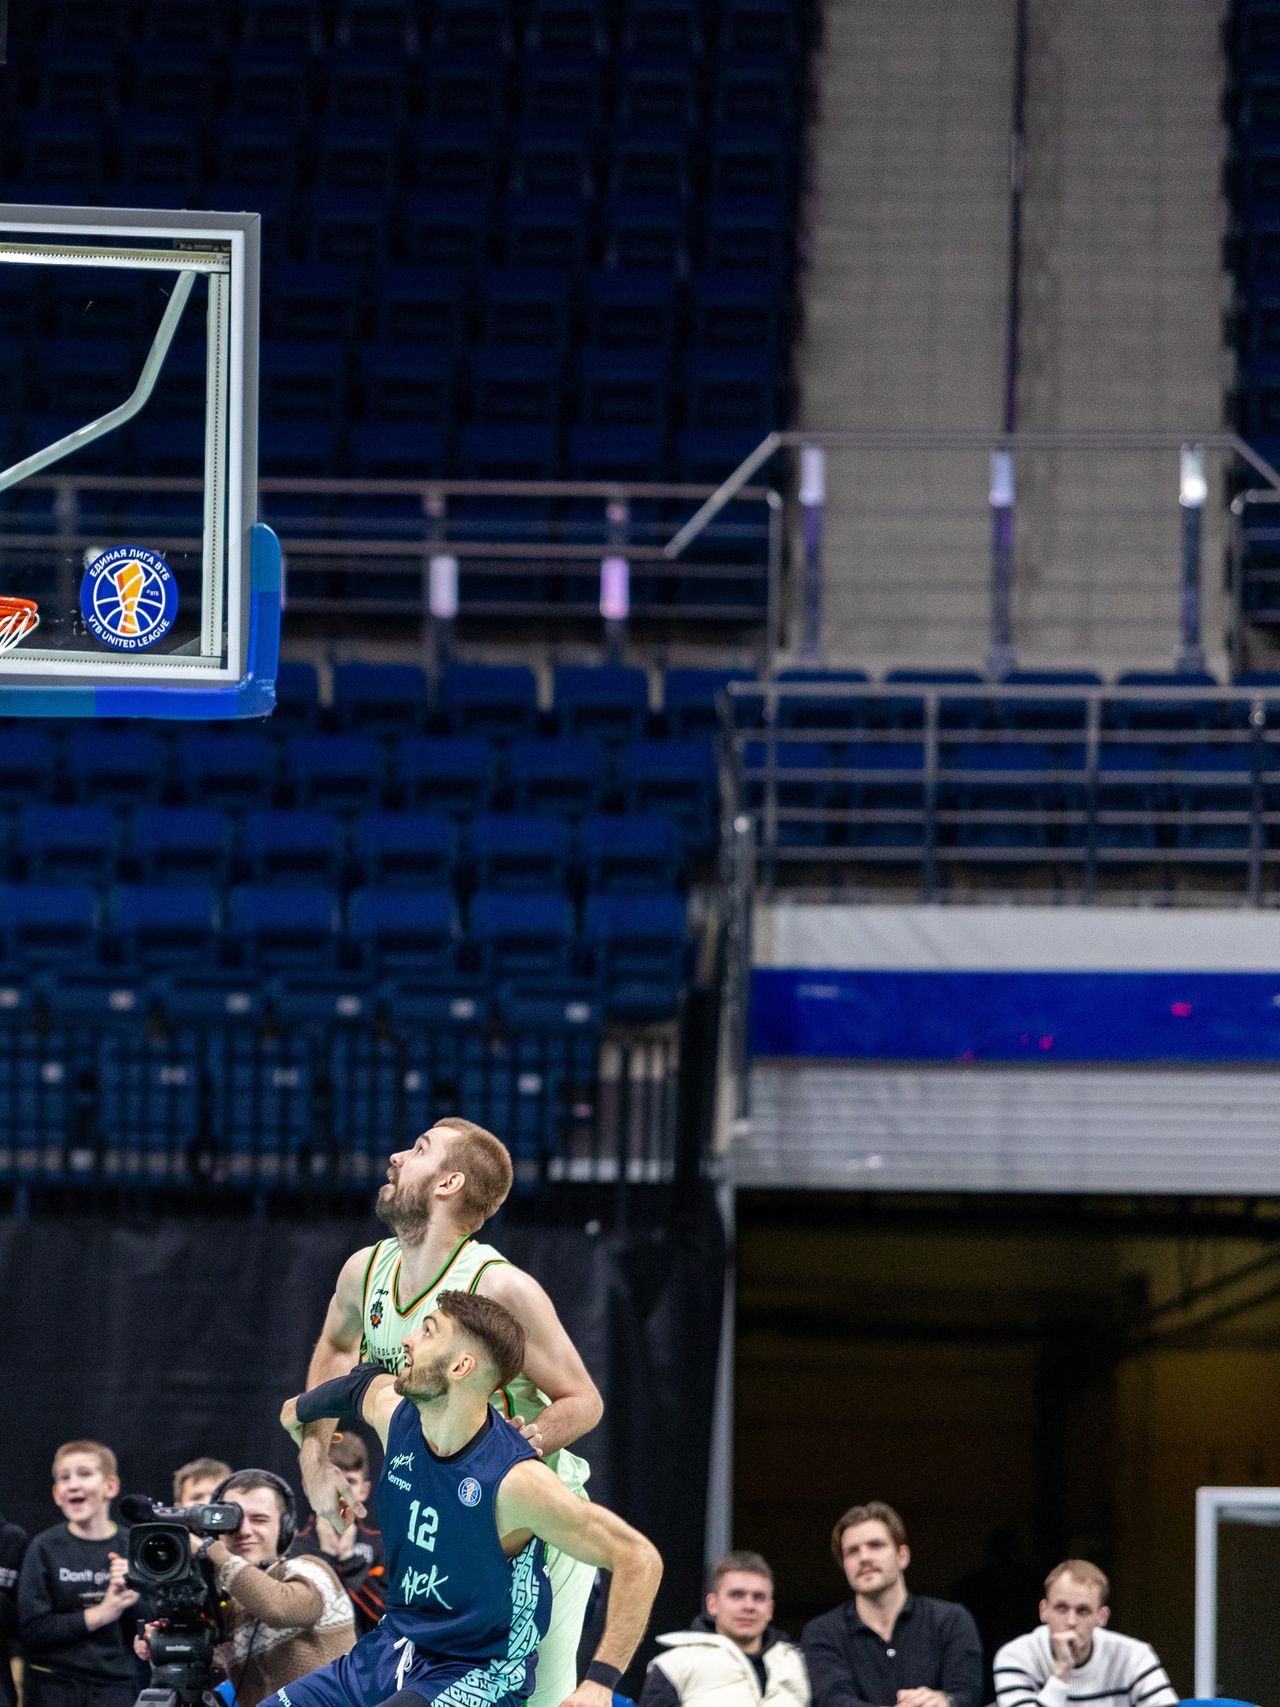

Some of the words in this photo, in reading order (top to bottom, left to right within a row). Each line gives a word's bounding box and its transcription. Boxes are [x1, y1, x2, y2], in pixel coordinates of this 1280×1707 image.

[89, 548, 127, 578] ЕДИНАЯ
[128, 549, 154, 565] ЛИГА
[154, 561, 171, 581] ВТБ
[88, 614, 103, 634] VTB
[101, 631, 136, 649] UNITED
[137, 618, 170, 647] LEAGUE
[407, 1500, 439, 1552] 12
